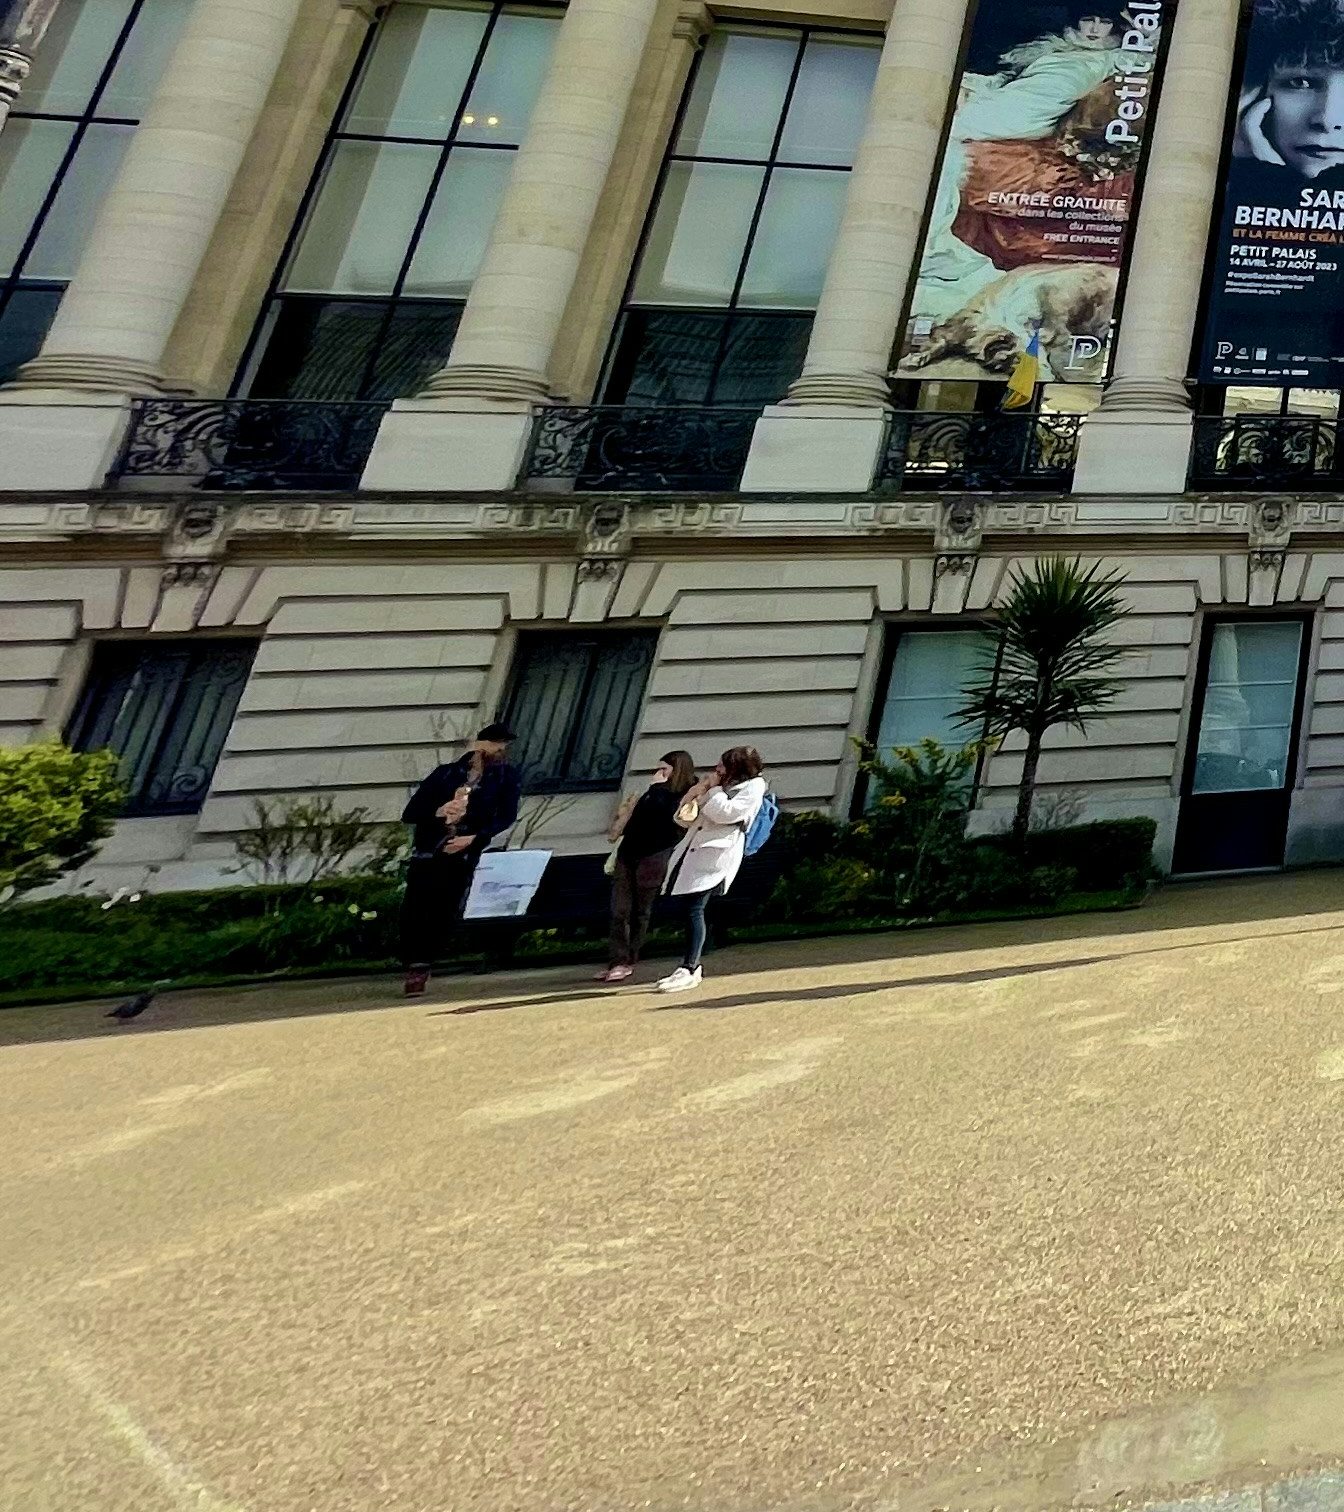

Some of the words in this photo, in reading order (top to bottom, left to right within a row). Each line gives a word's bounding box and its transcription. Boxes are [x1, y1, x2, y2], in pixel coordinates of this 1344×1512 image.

[1105, 59, 1152, 144] Petit
[1053, 195, 1127, 211] GRATUITE
[1017, 208, 1045, 219] dans
[1046, 209, 1063, 220] les
[1065, 210, 1128, 222] collections
[1069, 221, 1084, 231] du
[1085, 222, 1122, 233] musée
[1043, 233, 1069, 243] FREE
[1069, 234, 1121, 245] ENTRANCE
[1232, 228, 1248, 238] ET
[1248, 229, 1263, 239] LA
[1265, 230, 1306, 242] FEMME
[1230, 245, 1270, 258] PETIT
[1271, 247, 1317, 260] PALAIS
[1241, 258, 1268, 268] AVRIL
